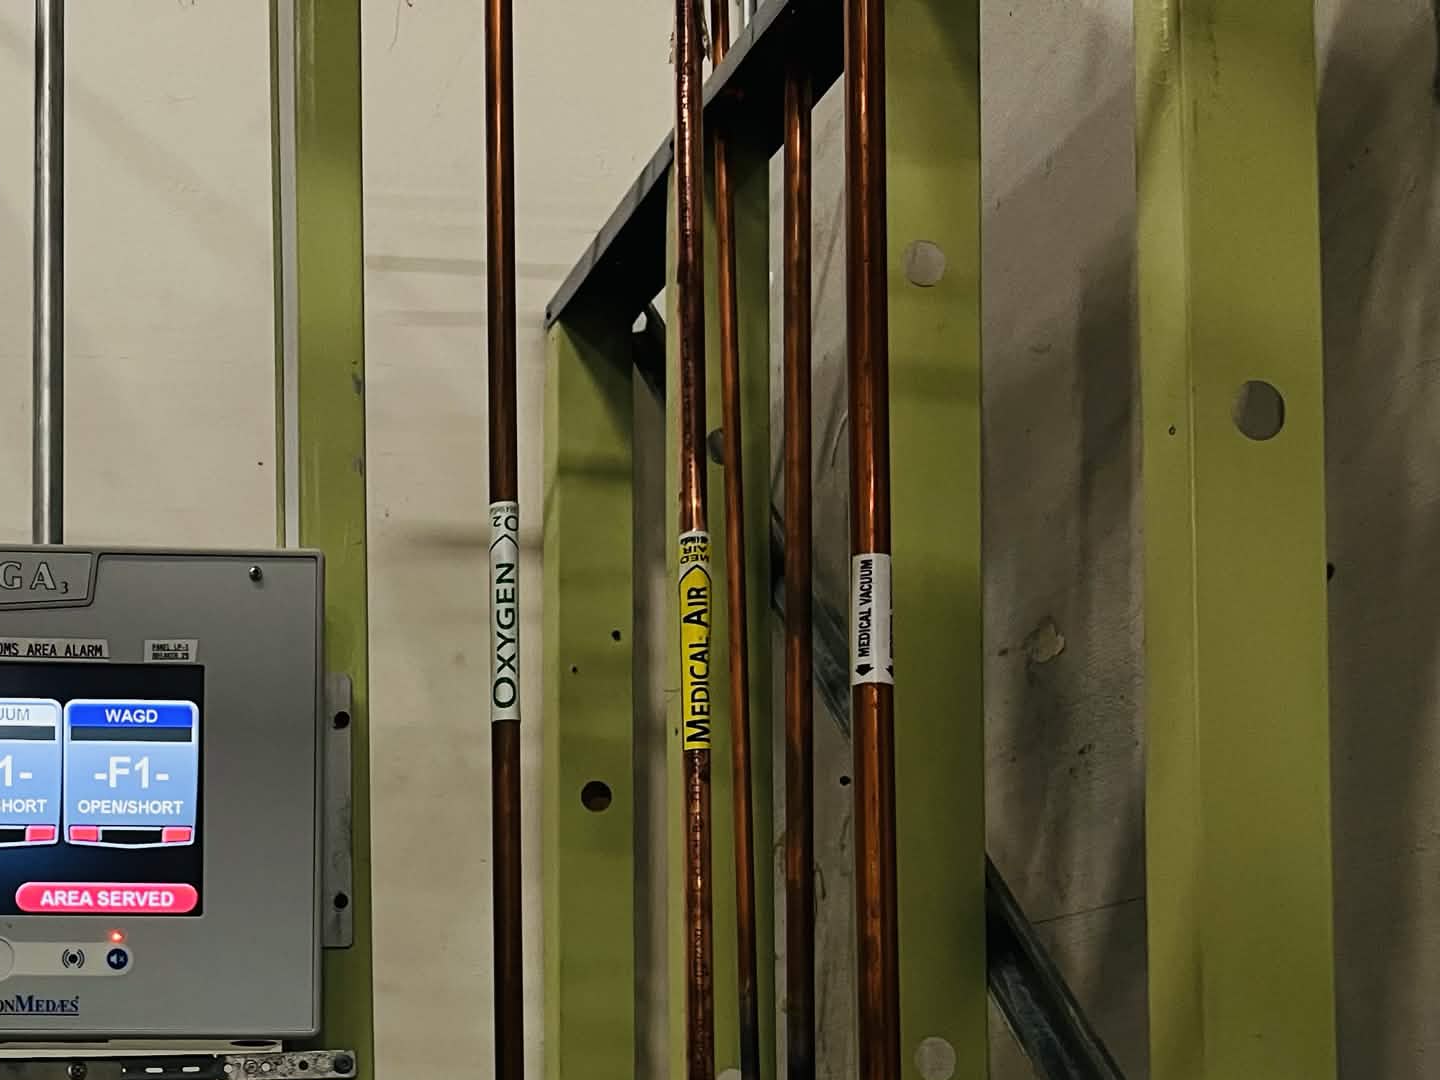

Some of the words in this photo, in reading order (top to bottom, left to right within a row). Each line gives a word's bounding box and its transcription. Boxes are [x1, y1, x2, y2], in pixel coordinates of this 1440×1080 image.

[859, 559, 873, 606] VACUUM
[683, 586, 709, 626] AIR
[492, 562, 517, 709] OXYGEN
[858, 607, 872, 657] MEDICAL
[27, 644, 57, 657] AREA
[64, 644, 103, 657] ALARM
[686, 636, 710, 744] MEDICAL
[105, 709, 158, 723] WAGD
[94, 756, 169, 789] -F1-
[77, 800, 184, 815] OPEN/SHORT
[40, 890, 93, 907] AREA
[97, 890, 174, 908] SERVED
